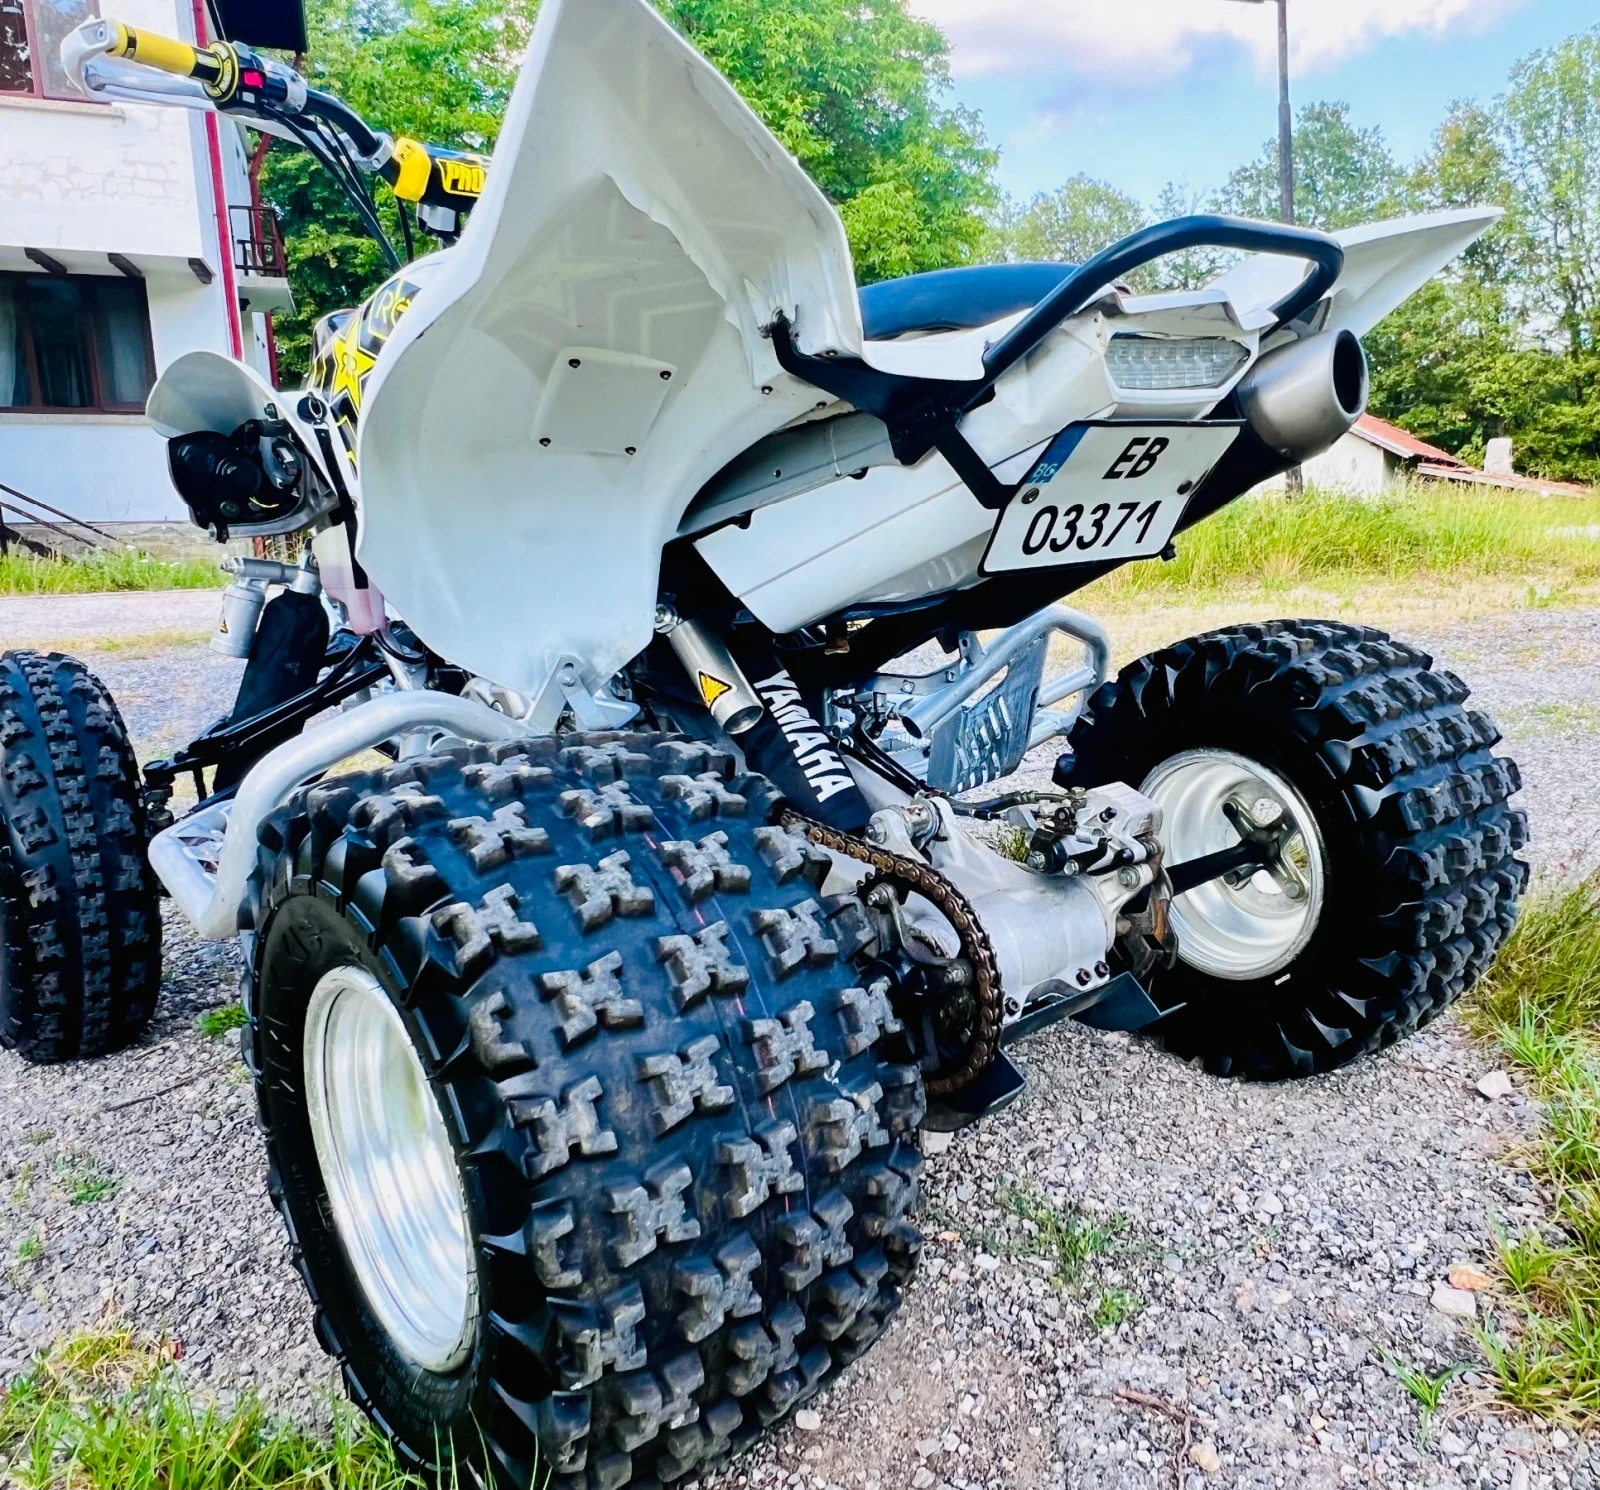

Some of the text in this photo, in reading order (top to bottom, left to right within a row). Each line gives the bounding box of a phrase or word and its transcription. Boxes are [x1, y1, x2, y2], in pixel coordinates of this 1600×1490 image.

[1032, 462, 1058, 478] BG
[1102, 436, 1169, 480] EB
[1022, 500, 1162, 555] 03371
[753, 669, 855, 803] YAMAHA
